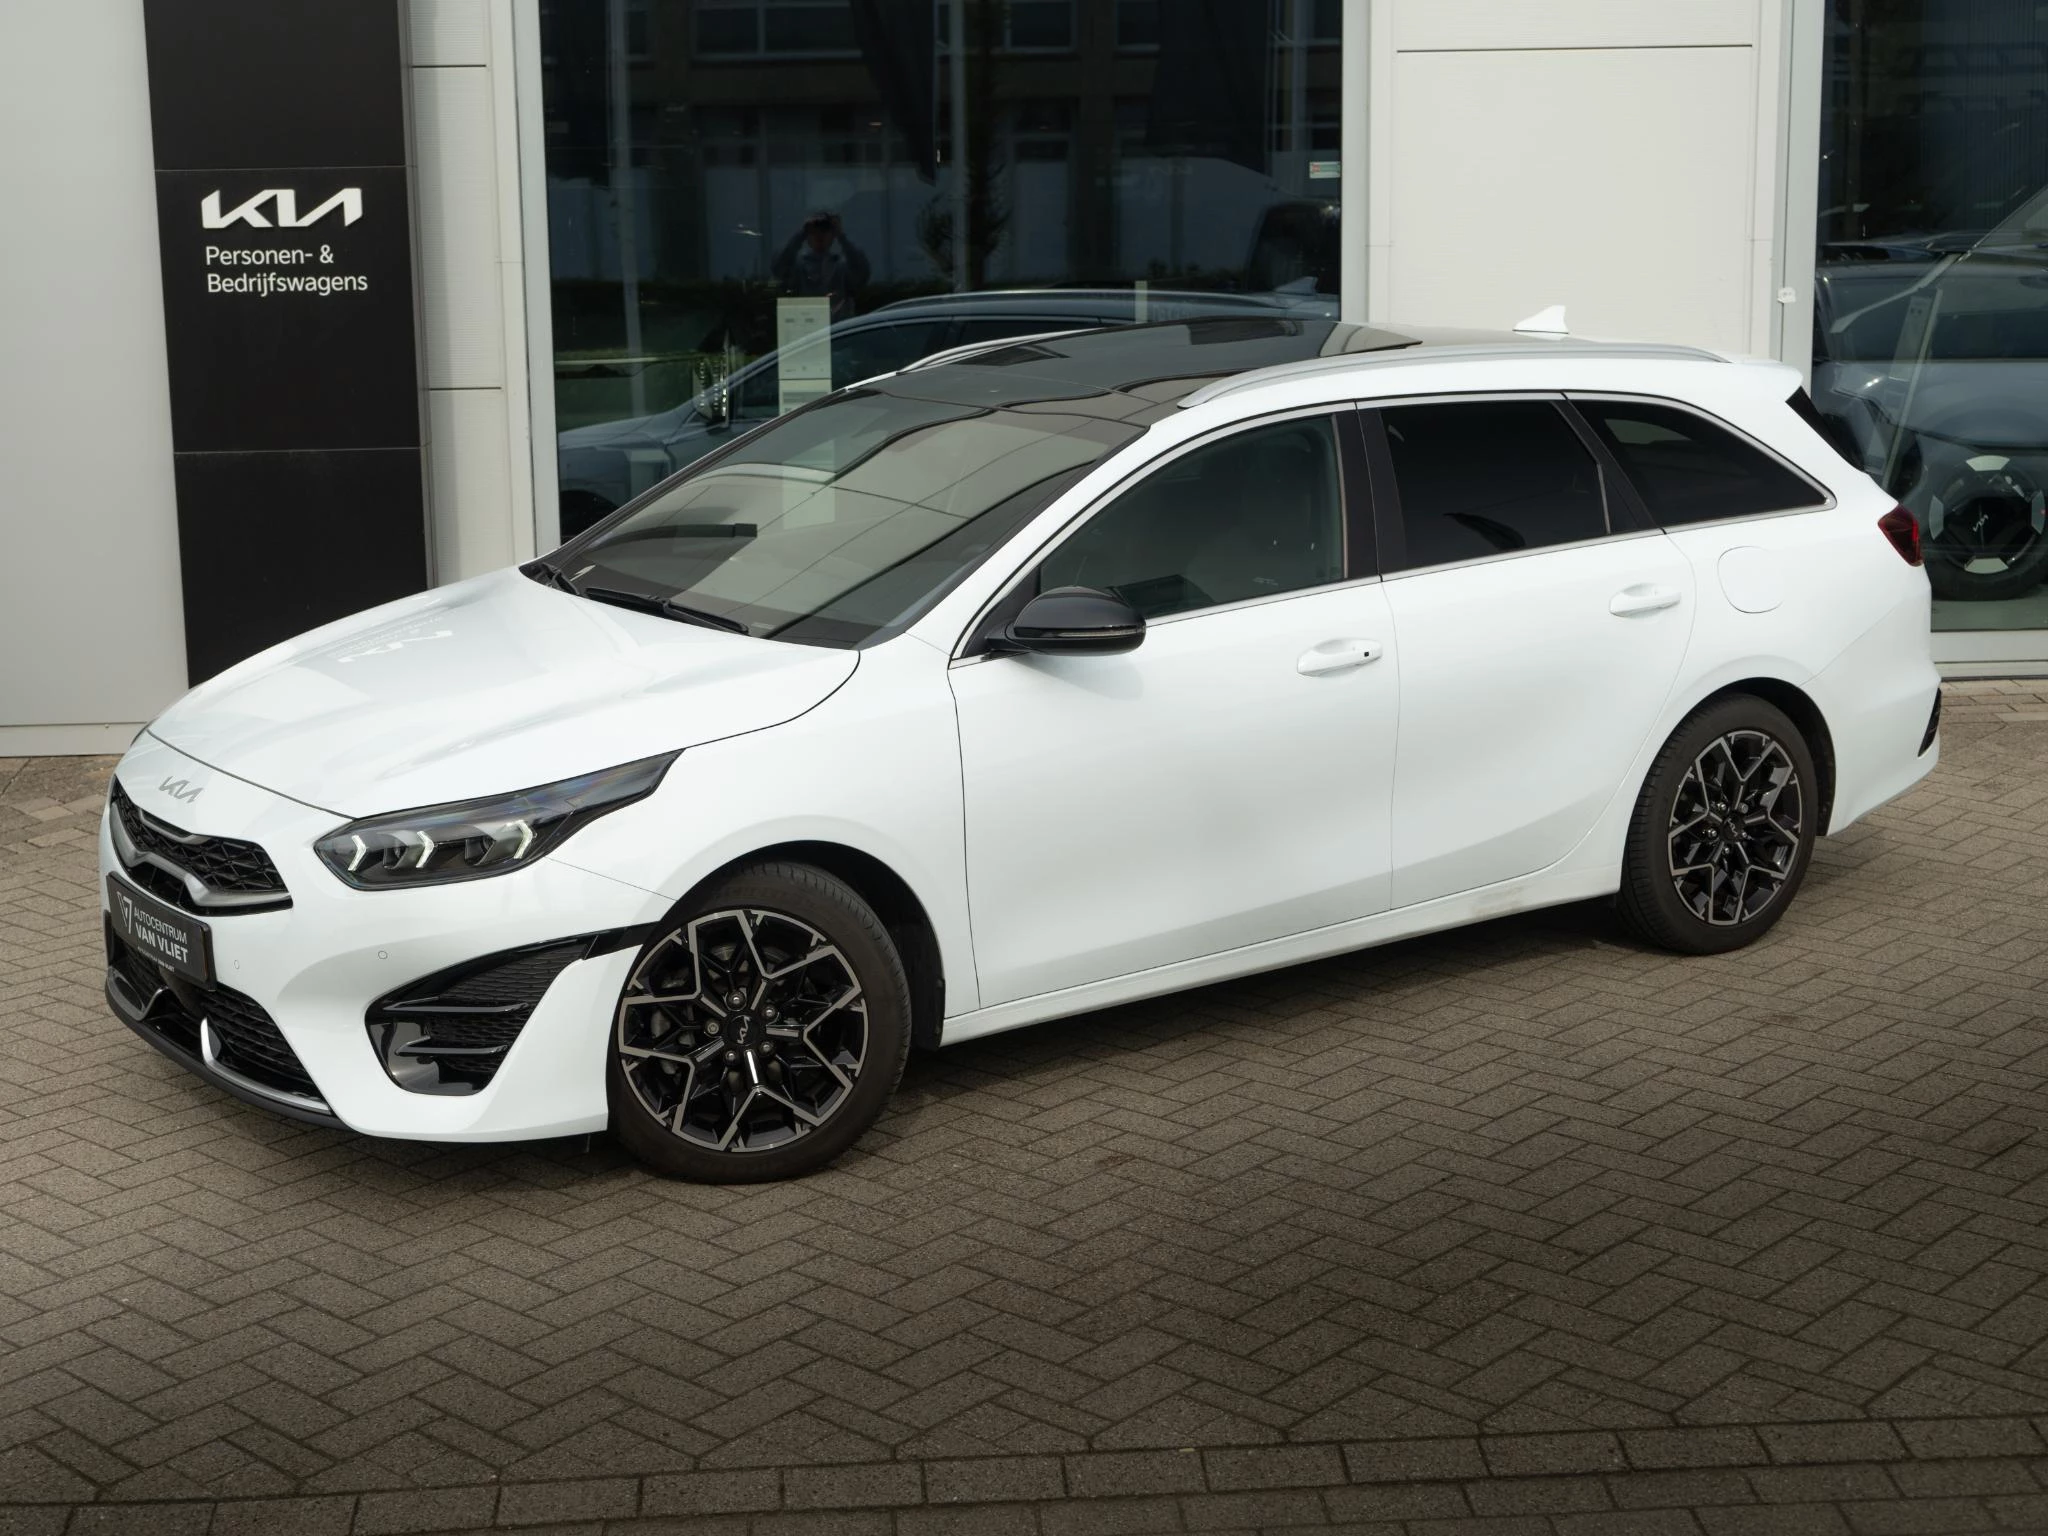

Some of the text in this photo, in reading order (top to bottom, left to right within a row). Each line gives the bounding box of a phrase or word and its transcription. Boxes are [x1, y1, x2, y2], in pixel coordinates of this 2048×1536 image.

[201, 187, 363, 229] KIA
[205, 244, 334, 266] Personen- &
[206, 271, 368, 297] Bedrijfswagens
[158, 776, 204, 804] KIA
[133, 906, 188, 945] AUTOCENTRUM
[135, 922, 156, 948] VAN
[157, 935, 188, 964] VLIET
